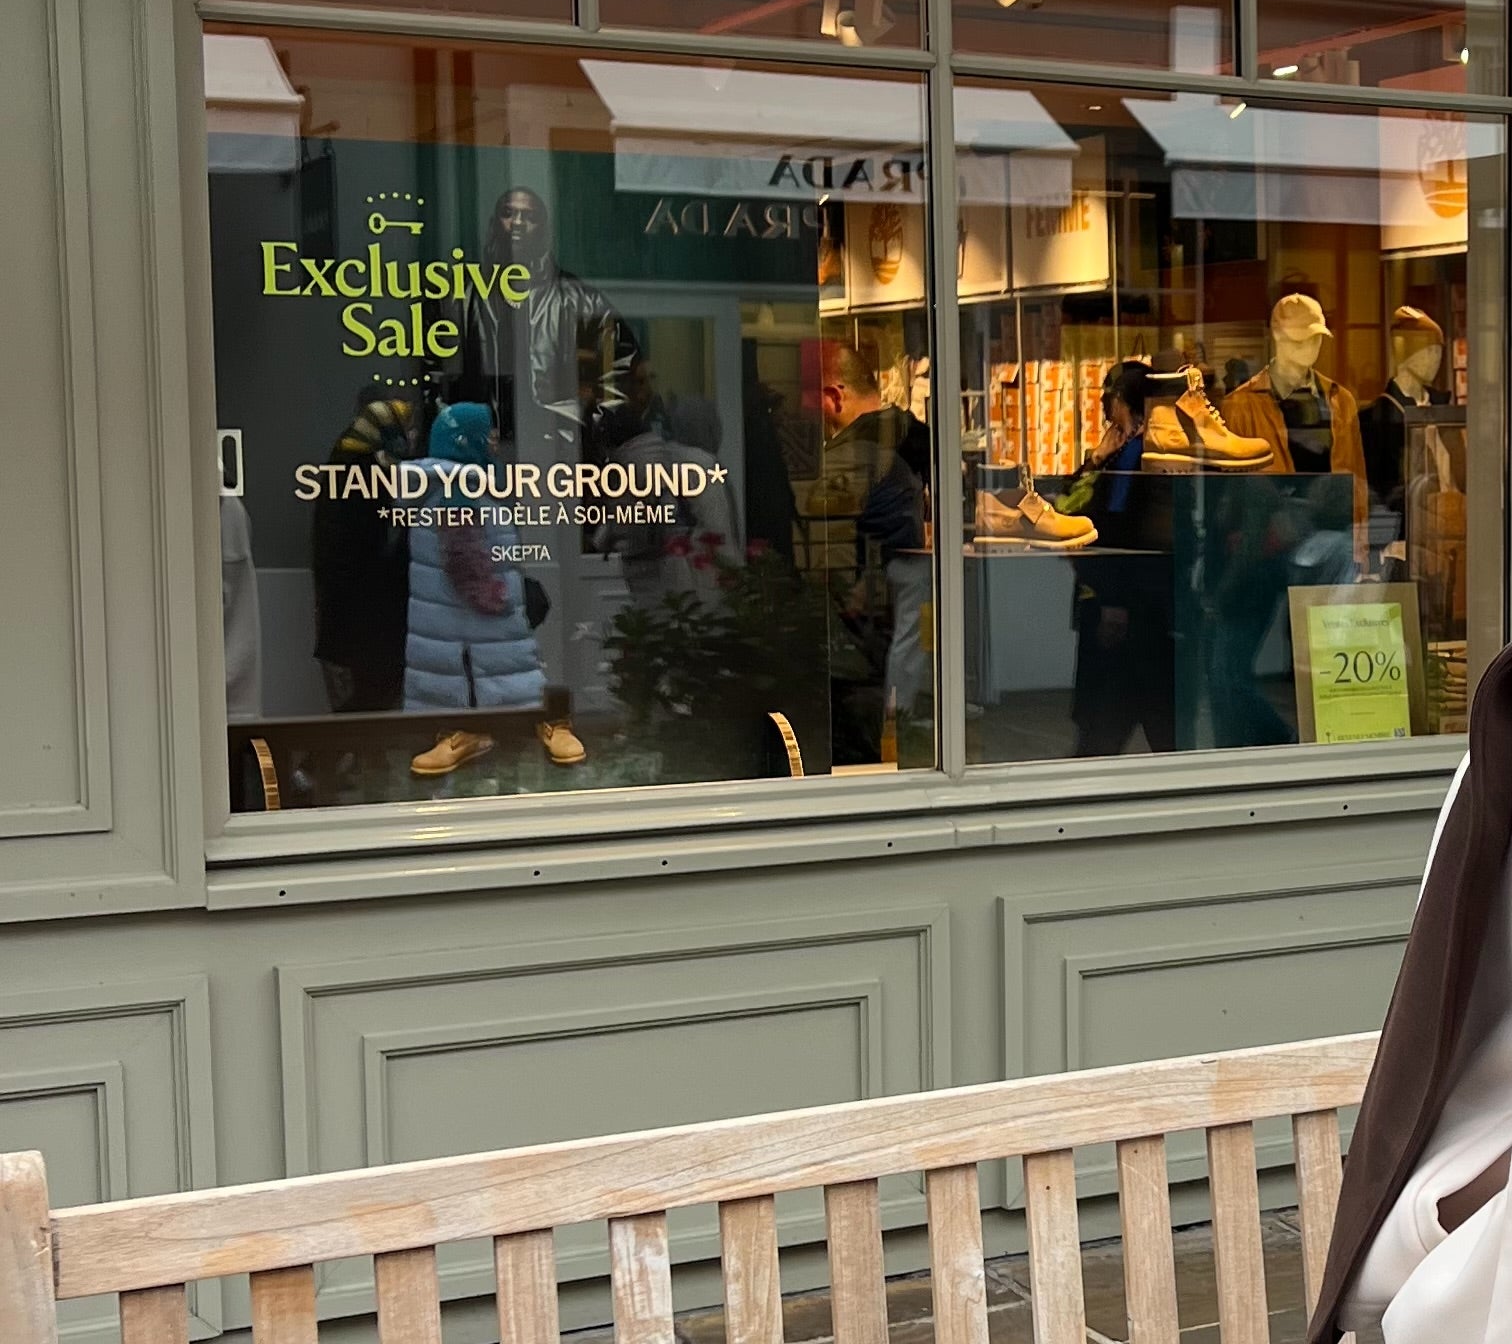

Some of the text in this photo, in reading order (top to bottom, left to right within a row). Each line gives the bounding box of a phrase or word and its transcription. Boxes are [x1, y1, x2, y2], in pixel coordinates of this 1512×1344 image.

[260, 241, 531, 302] Exclusive
[341, 301, 460, 357] Sale
[294, 464, 428, 501] STAND
[432, 464, 541, 499] YOUR
[479, 502, 551, 527] FIDÈLE
[556, 500, 570, 525] À
[574, 501, 676, 525] SOI-MÊME
[490, 544, 551, 562] SKEPTA
[1319, 650, 1401, 684] -20%
